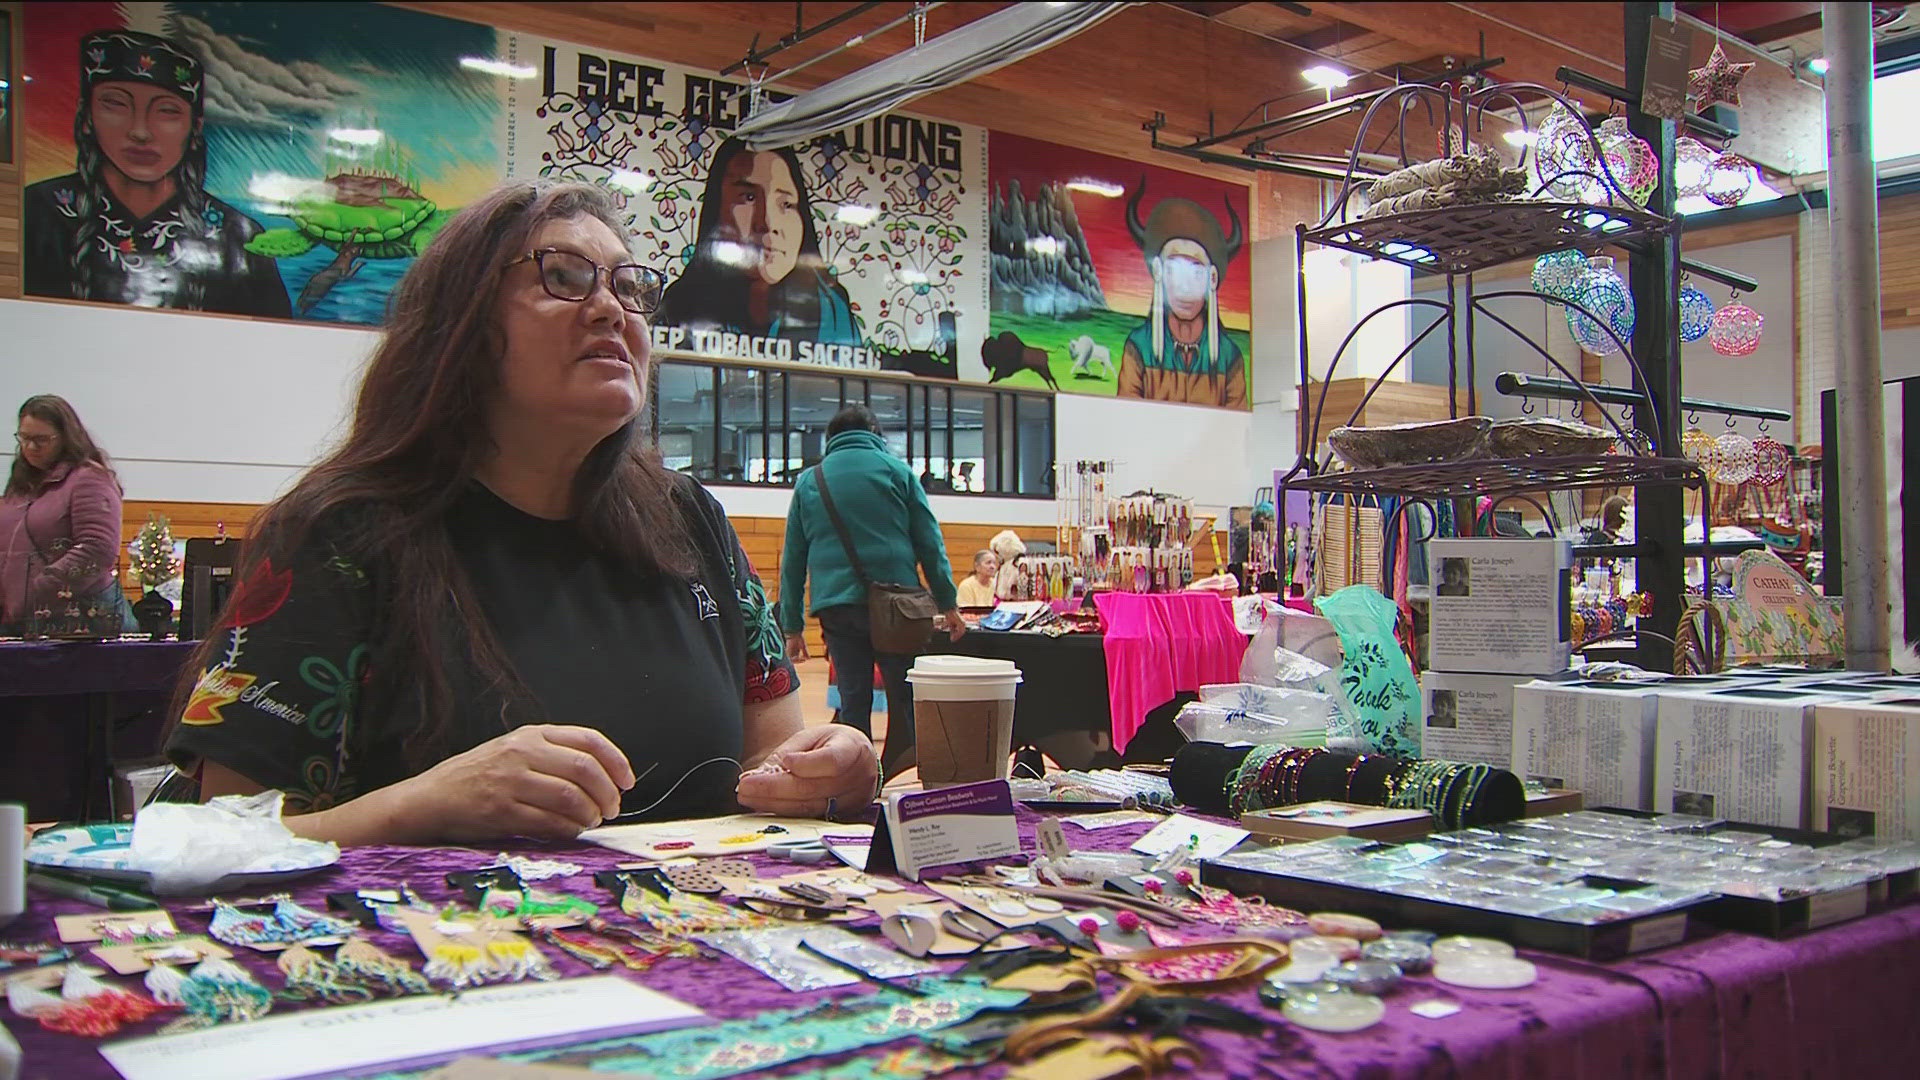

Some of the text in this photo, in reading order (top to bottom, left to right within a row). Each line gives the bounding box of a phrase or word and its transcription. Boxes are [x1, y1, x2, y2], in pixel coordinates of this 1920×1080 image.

[542, 45, 556, 98] I
[577, 52, 665, 118] SEE
[693, 330, 793, 362] TOBACCO
[1471, 557, 1515, 567] Carla Joseph
[1753, 577, 1797, 604] CATHAY COLLECTION
[240, 681, 308, 725] America
